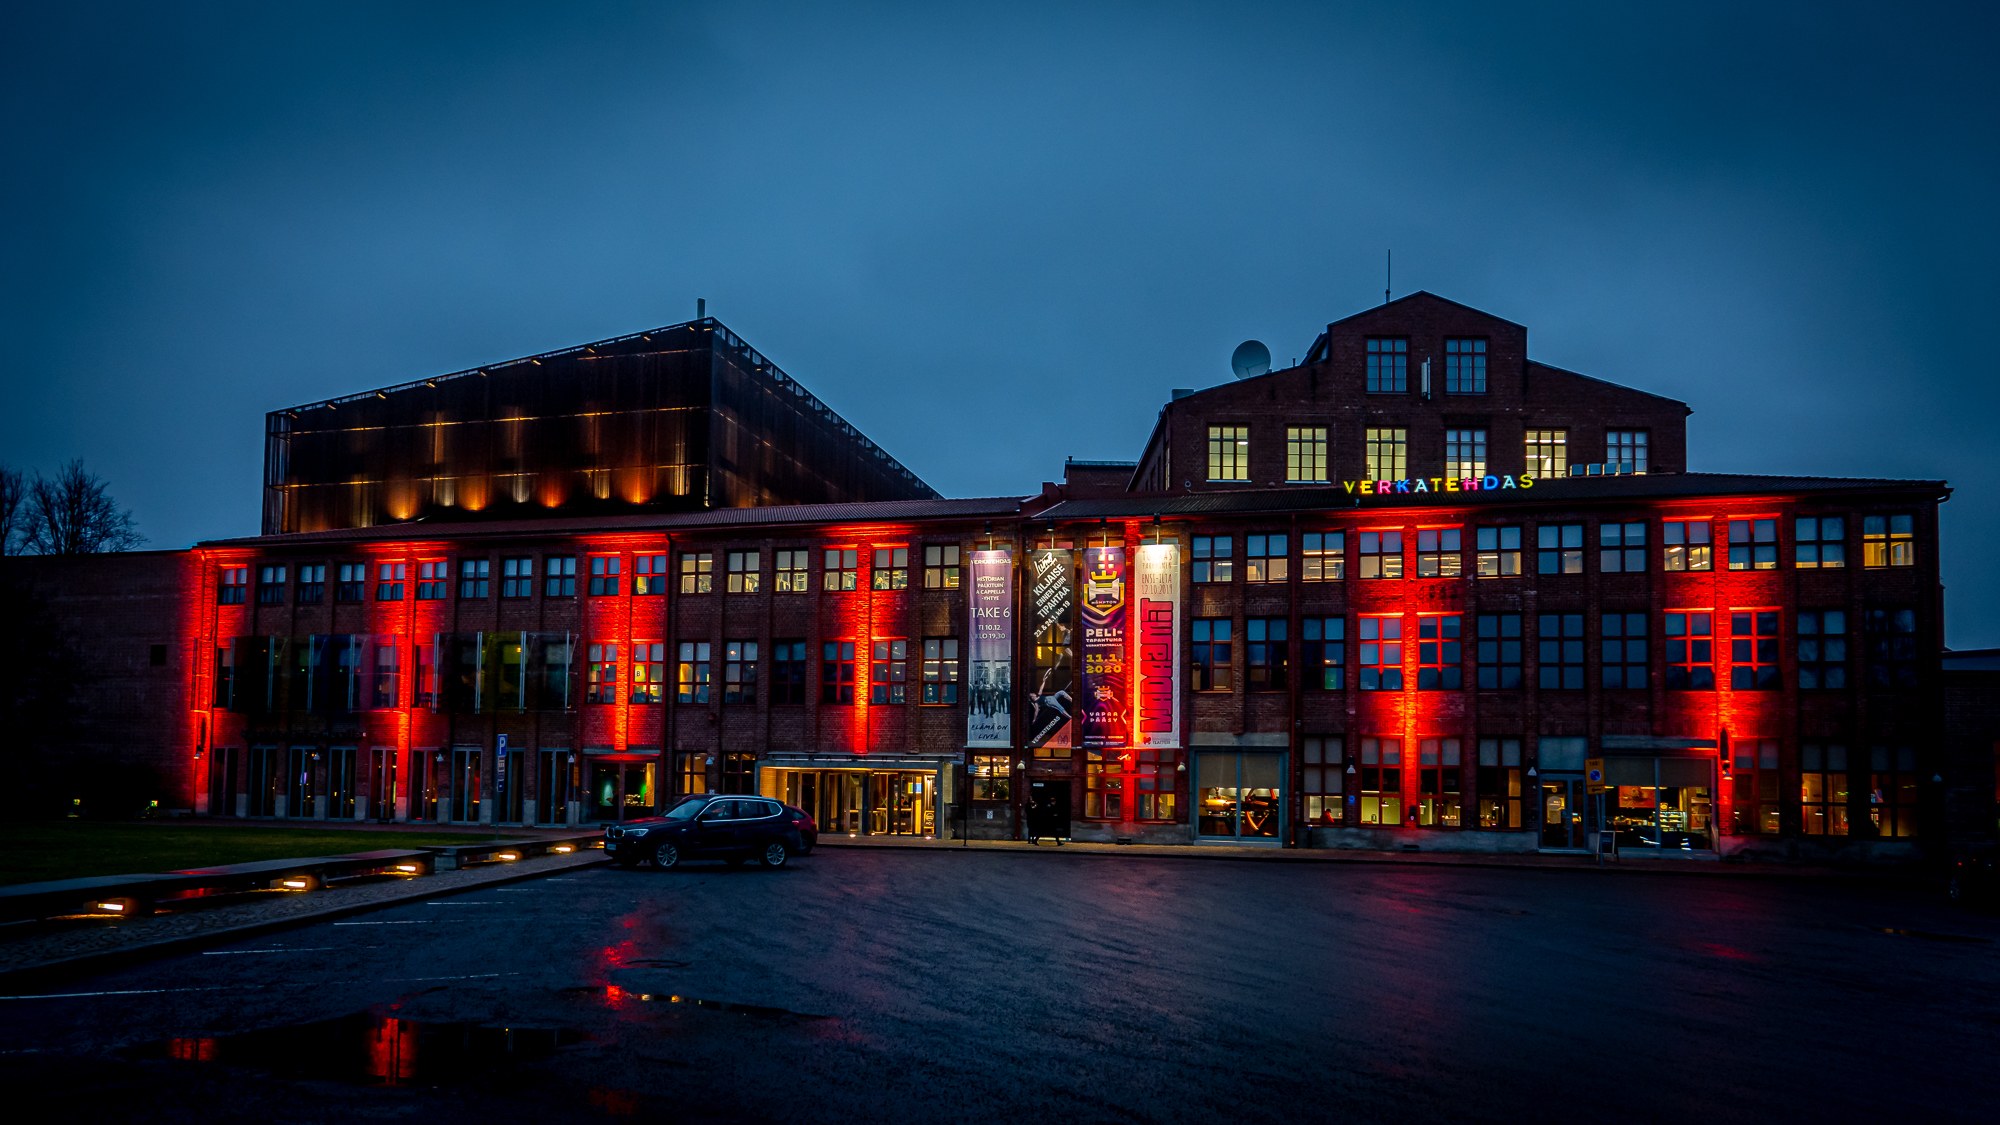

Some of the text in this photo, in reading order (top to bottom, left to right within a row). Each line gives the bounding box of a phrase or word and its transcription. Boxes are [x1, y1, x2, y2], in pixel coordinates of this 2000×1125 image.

[1344, 474, 1534, 494] VERKATEHDAS
[1033, 564, 1065, 596] KILJAISE
[1036, 576, 1066, 607] ENNEN KUIN
[1037, 586, 1070, 618] TIPAHTAA
[970, 607, 1010, 618] TAKE 6
[1086, 628, 1122, 637] PELI-
[1086, 654, 1122, 662] 11.1.
[1086, 665, 1122, 673] 2020
[1032, 715, 1060, 744] VERKATEHDAS
